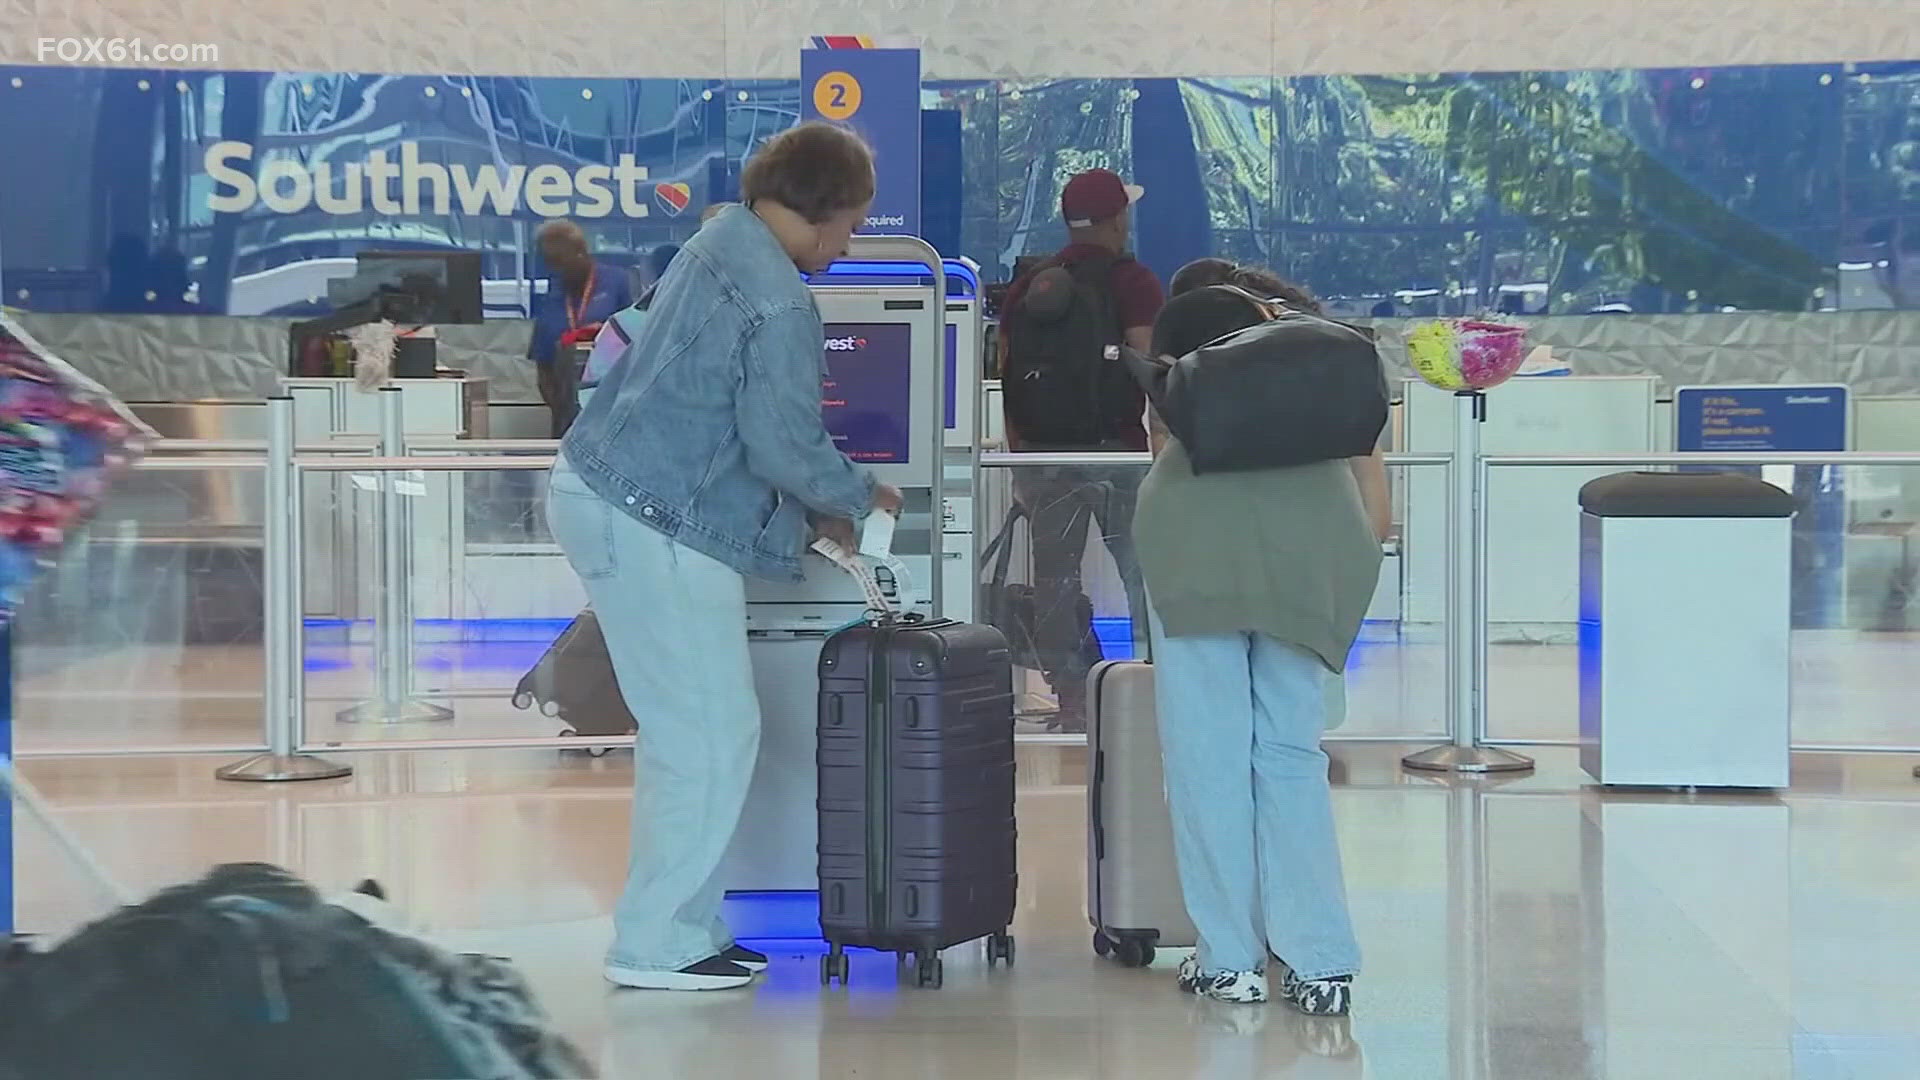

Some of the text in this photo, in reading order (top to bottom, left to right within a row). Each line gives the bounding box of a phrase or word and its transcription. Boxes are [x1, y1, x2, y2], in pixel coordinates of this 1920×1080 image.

[830, 83, 846, 108] 2
[204, 139, 650, 219] Southwest
[863, 214, 904, 228] equired
